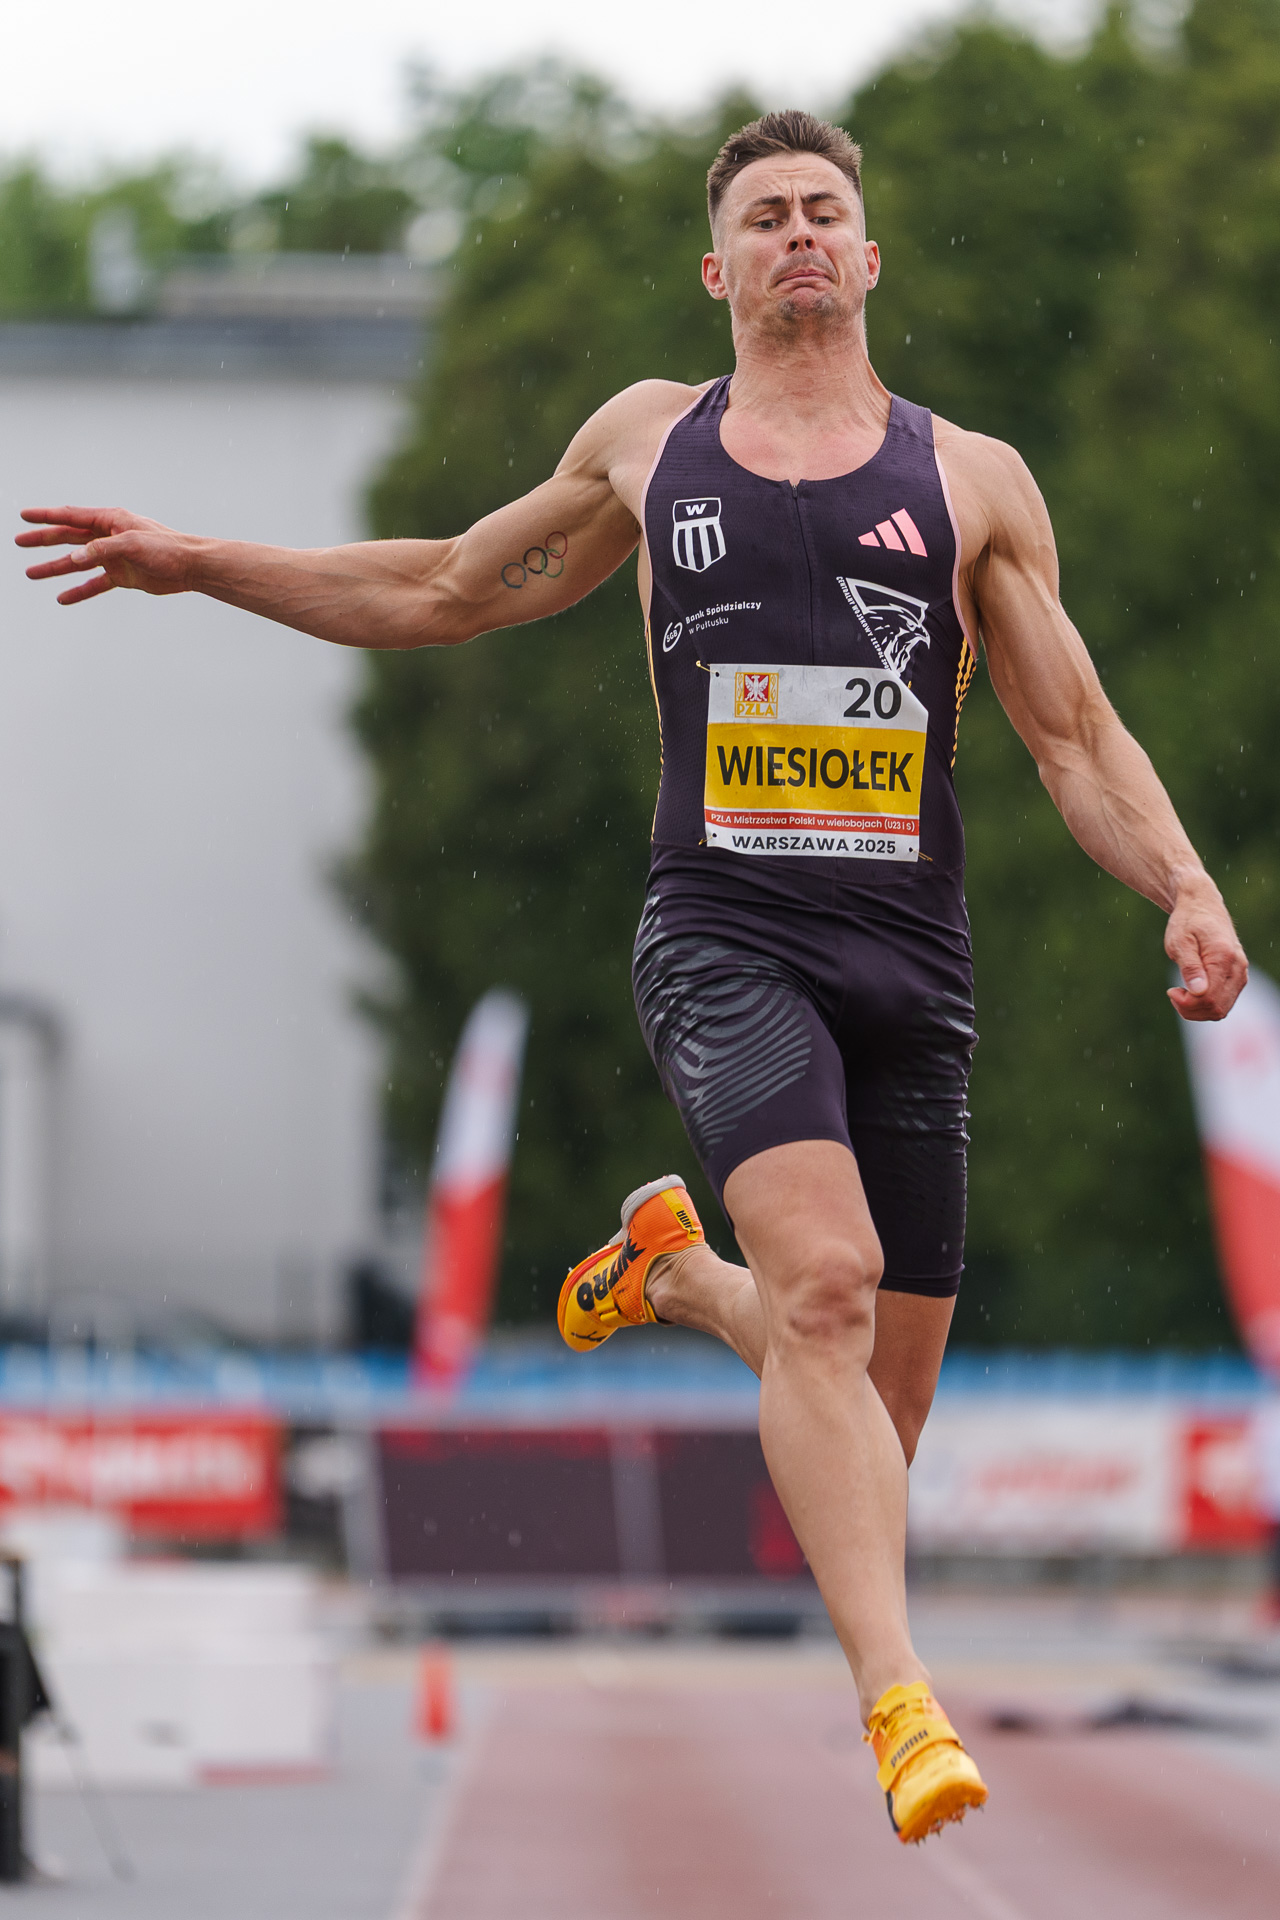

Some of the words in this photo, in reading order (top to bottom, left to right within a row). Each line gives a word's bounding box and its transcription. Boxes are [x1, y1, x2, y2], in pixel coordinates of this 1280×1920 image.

[685, 503, 708, 516] W
[685, 610, 705, 624] Bank
[705, 601, 761, 616] Spółdzielczy
[852, 603, 873, 636] WOJSKOWY
[695, 617, 729, 632] Pułtusku
[666, 629, 678, 643] SGB
[843, 677, 902, 720] 20
[736, 703, 775, 717] PZLA
[716, 745, 914, 793] WIESIOŁEK
[710, 813, 731, 823] PZLA
[733, 815, 787, 825] Mistrzostwa
[789, 816, 815, 825] Polski
[826, 818, 882, 830] wielobojach
[884, 818, 900, 830] (U23
[906, 821, 915, 832] S)
[731, 835, 849, 852] WARSZAWA
[854, 838, 896, 854] 2025
